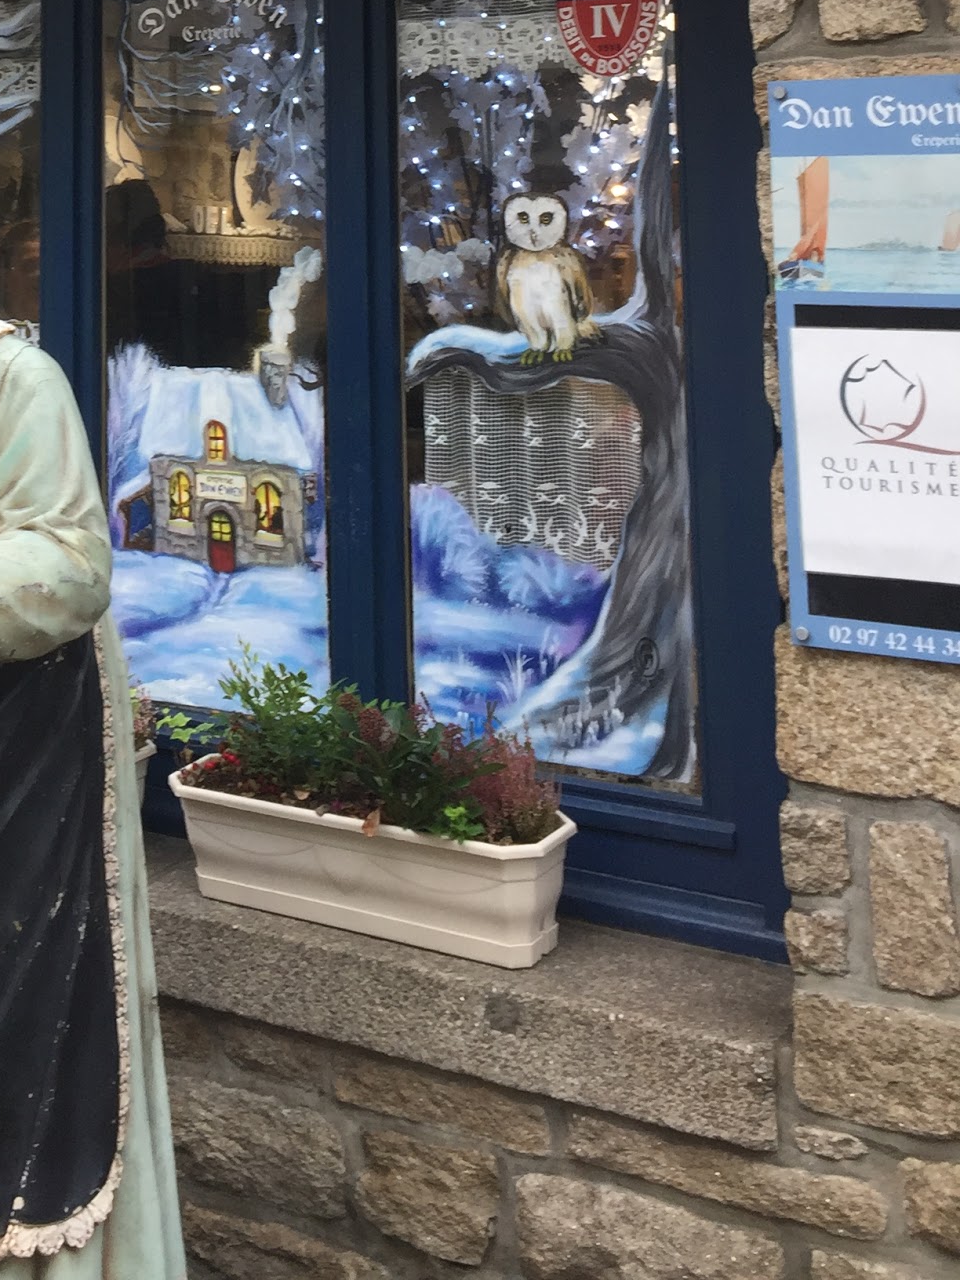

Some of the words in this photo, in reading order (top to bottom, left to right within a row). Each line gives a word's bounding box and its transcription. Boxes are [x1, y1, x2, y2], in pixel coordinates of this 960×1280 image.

[558, 6, 586, 54] DEBIT
[595, 0, 658, 74] BOISSONS
[590, 3, 632, 39] IV
[778, 98, 854, 130] Dan
[866, 95, 960, 127] Ewen
[821, 456, 958, 477] QUALITÉ
[822, 475, 959, 497] TOURISME
[828, 625, 852, 644] 02
[856, 628, 879, 647] 97
[884, 632, 908, 651] 42
[912, 635, 936, 655] 44
